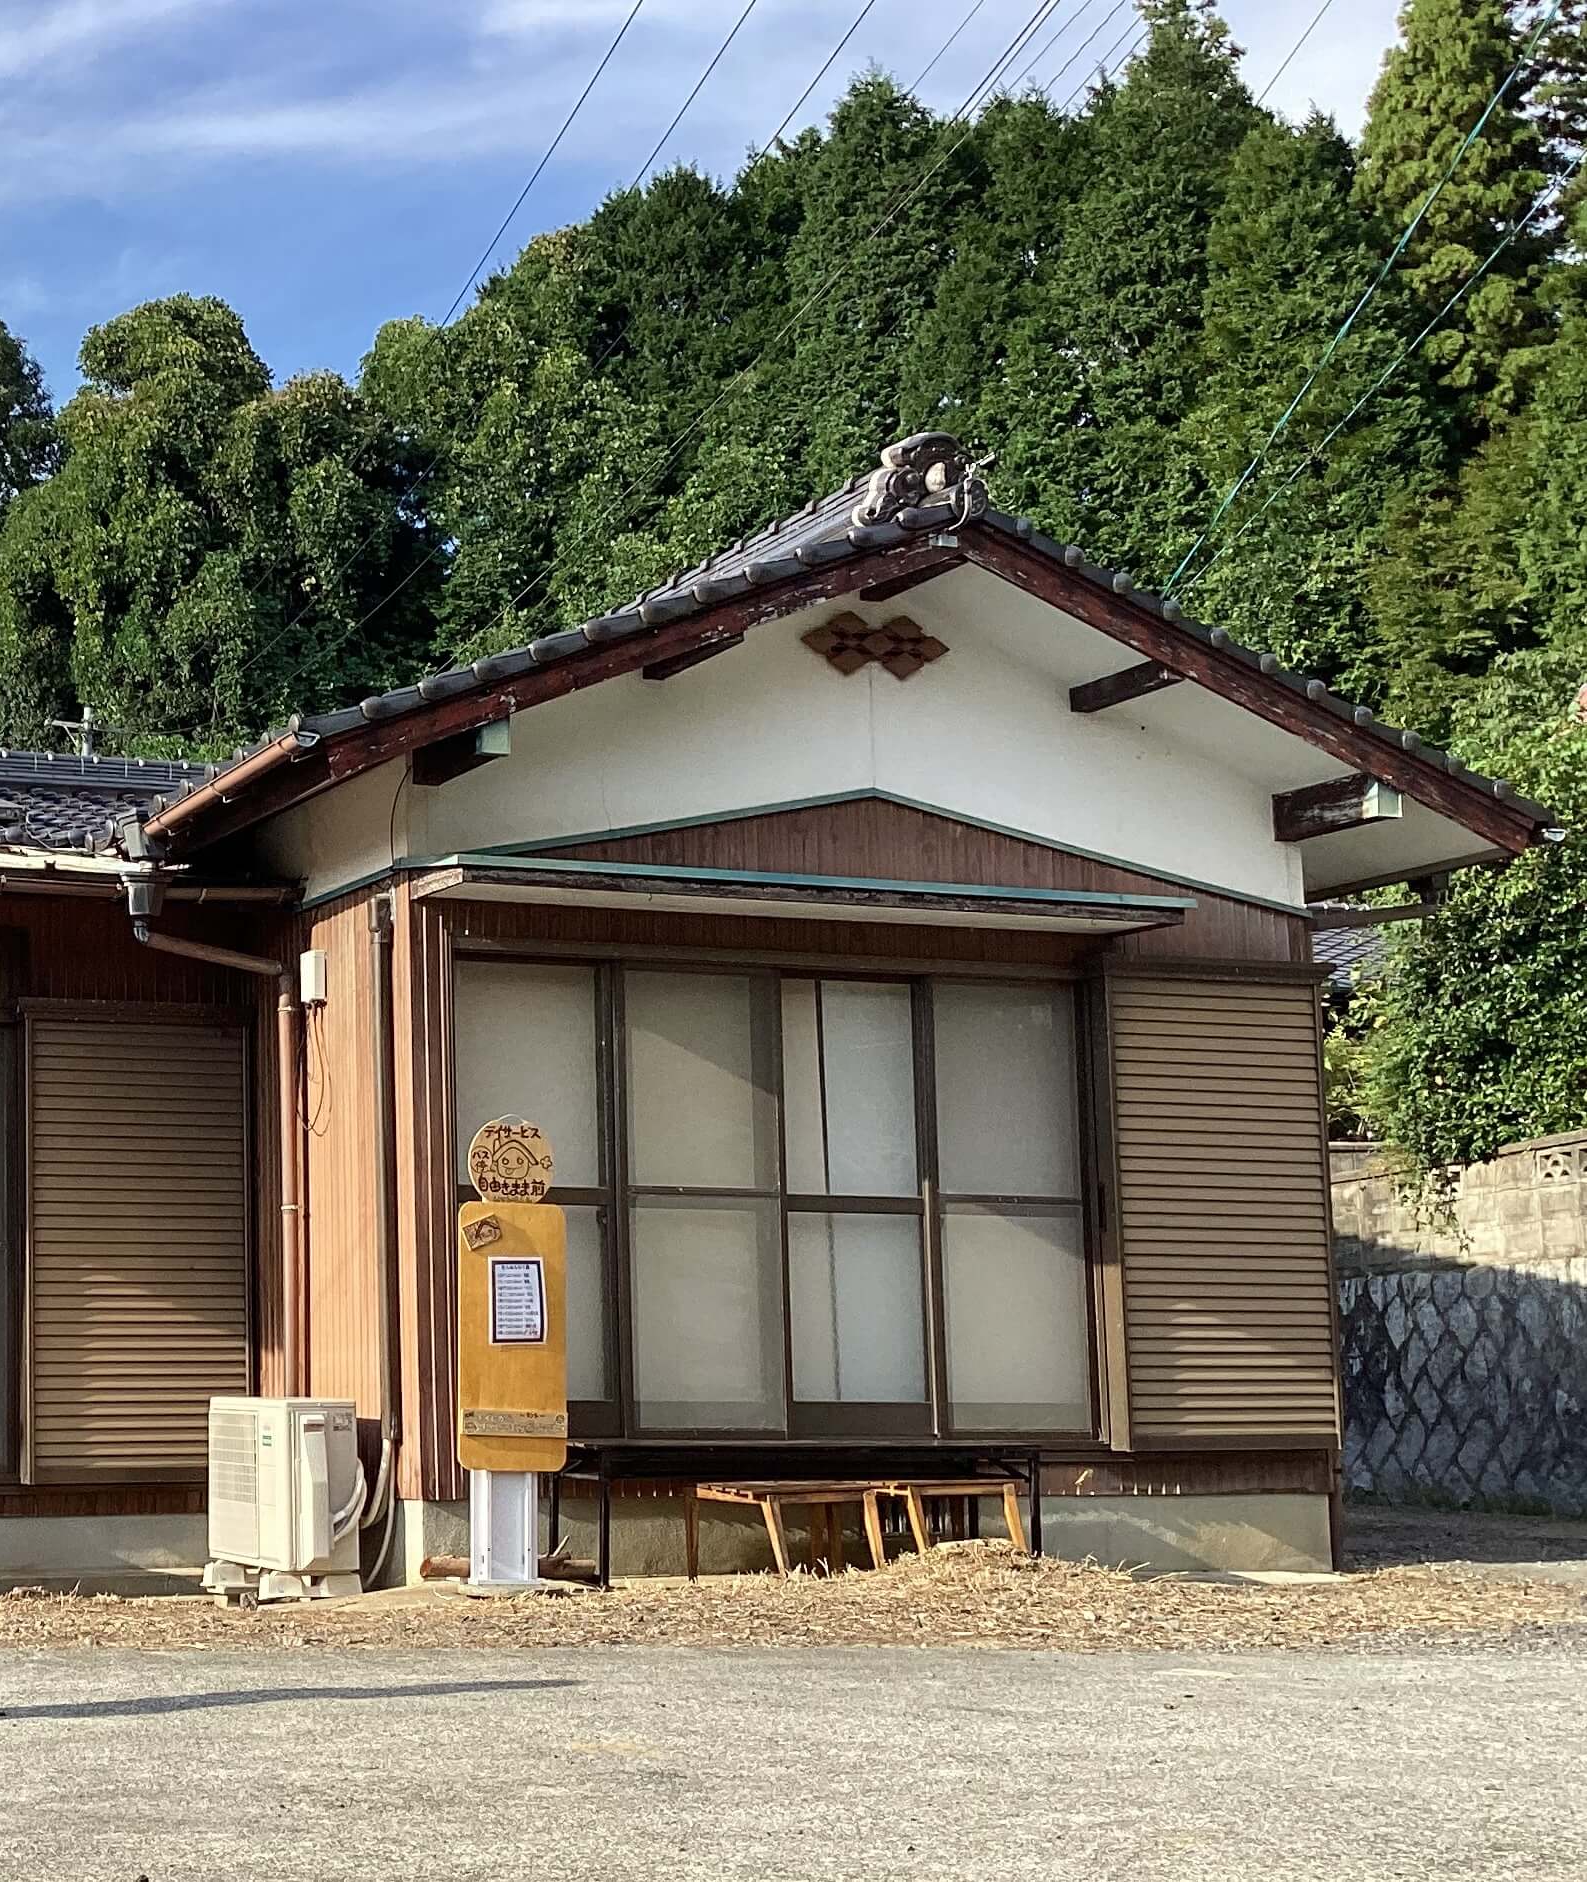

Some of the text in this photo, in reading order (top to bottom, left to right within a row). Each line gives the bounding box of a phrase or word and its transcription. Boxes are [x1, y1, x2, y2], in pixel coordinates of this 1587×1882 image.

[484, 1125, 542, 1139] デイサービス
[472, 1150, 489, 1159] バス
[478, 1175, 545, 1196] 自由きまま前
